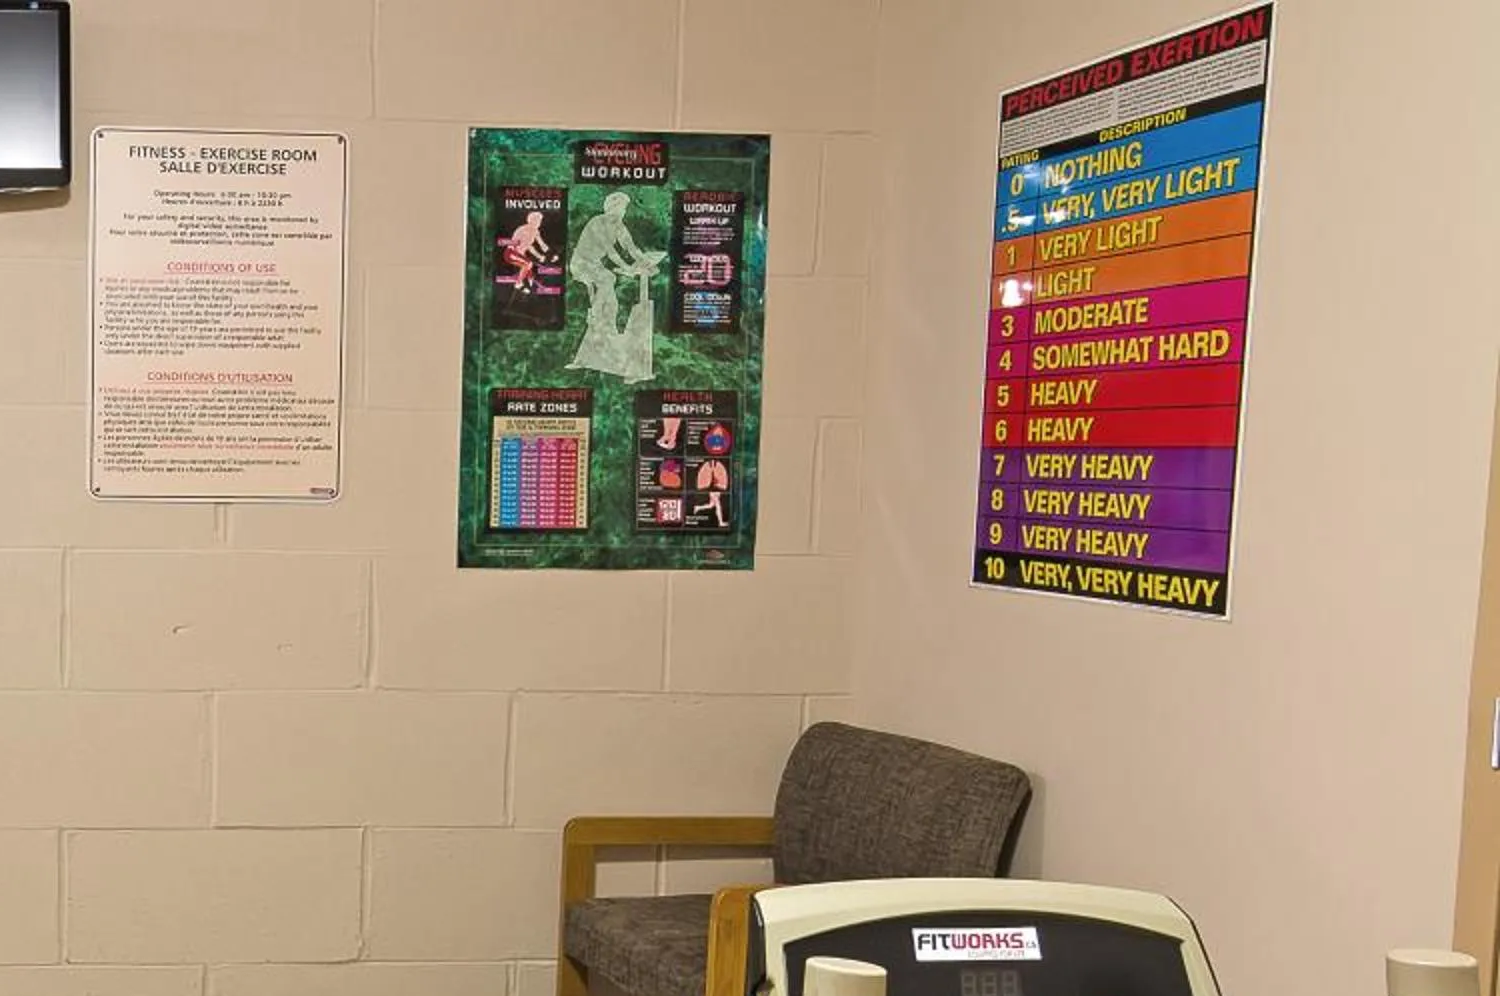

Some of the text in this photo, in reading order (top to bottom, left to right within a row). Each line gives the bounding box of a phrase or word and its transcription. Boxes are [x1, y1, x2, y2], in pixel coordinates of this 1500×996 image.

[1005, 58, 1124, 117] PERCEIVED
[1130, 10, 1265, 77] EXERTION
[1099, 106, 1187, 143] DESCRIPTION
[129, 146, 186, 159] FITNESS
[200, 148, 267, 160] EXERCISE
[272, 149, 318, 162] ROOM
[159, 162, 287, 175] SALLE D'EXERCISE
[581, 166, 667, 179] WORKOUT
[1011, 142, 1142, 196] 0 NOTHING
[1101, 179, 1159, 210] VERY
[1165, 159, 1241, 200] LIGHT
[505, 200, 561, 210] INVOLVED
[683, 204, 737, 214] WORKOUT
[1006, 215, 1163, 266] 1 VERY LIGHT
[167, 262, 276, 273] CONDITIONS OF USE
[1036, 266, 1096, 298] LIGHT
[1001, 298, 1149, 336] 3 MODERATE
[999, 330, 1231, 371] 4 SOMEWHAT HARD
[147, 372, 214, 382] CONDITIONS
[997, 379, 1098, 407] 5 HEAVY
[508, 402, 578, 413] RATE ZONES
[661, 404, 713, 414] BENEFITS
[995, 417, 1094, 442] 6 HEAVY
[993, 455, 1153, 480] 7 VERY HEAVY
[991, 489, 1152, 520] 8 VERY HEAVY
[989, 523, 1149, 558] 9 VERY HEAVY
[984, 557, 1219, 607] 10 VERY, VERY HEAVY
